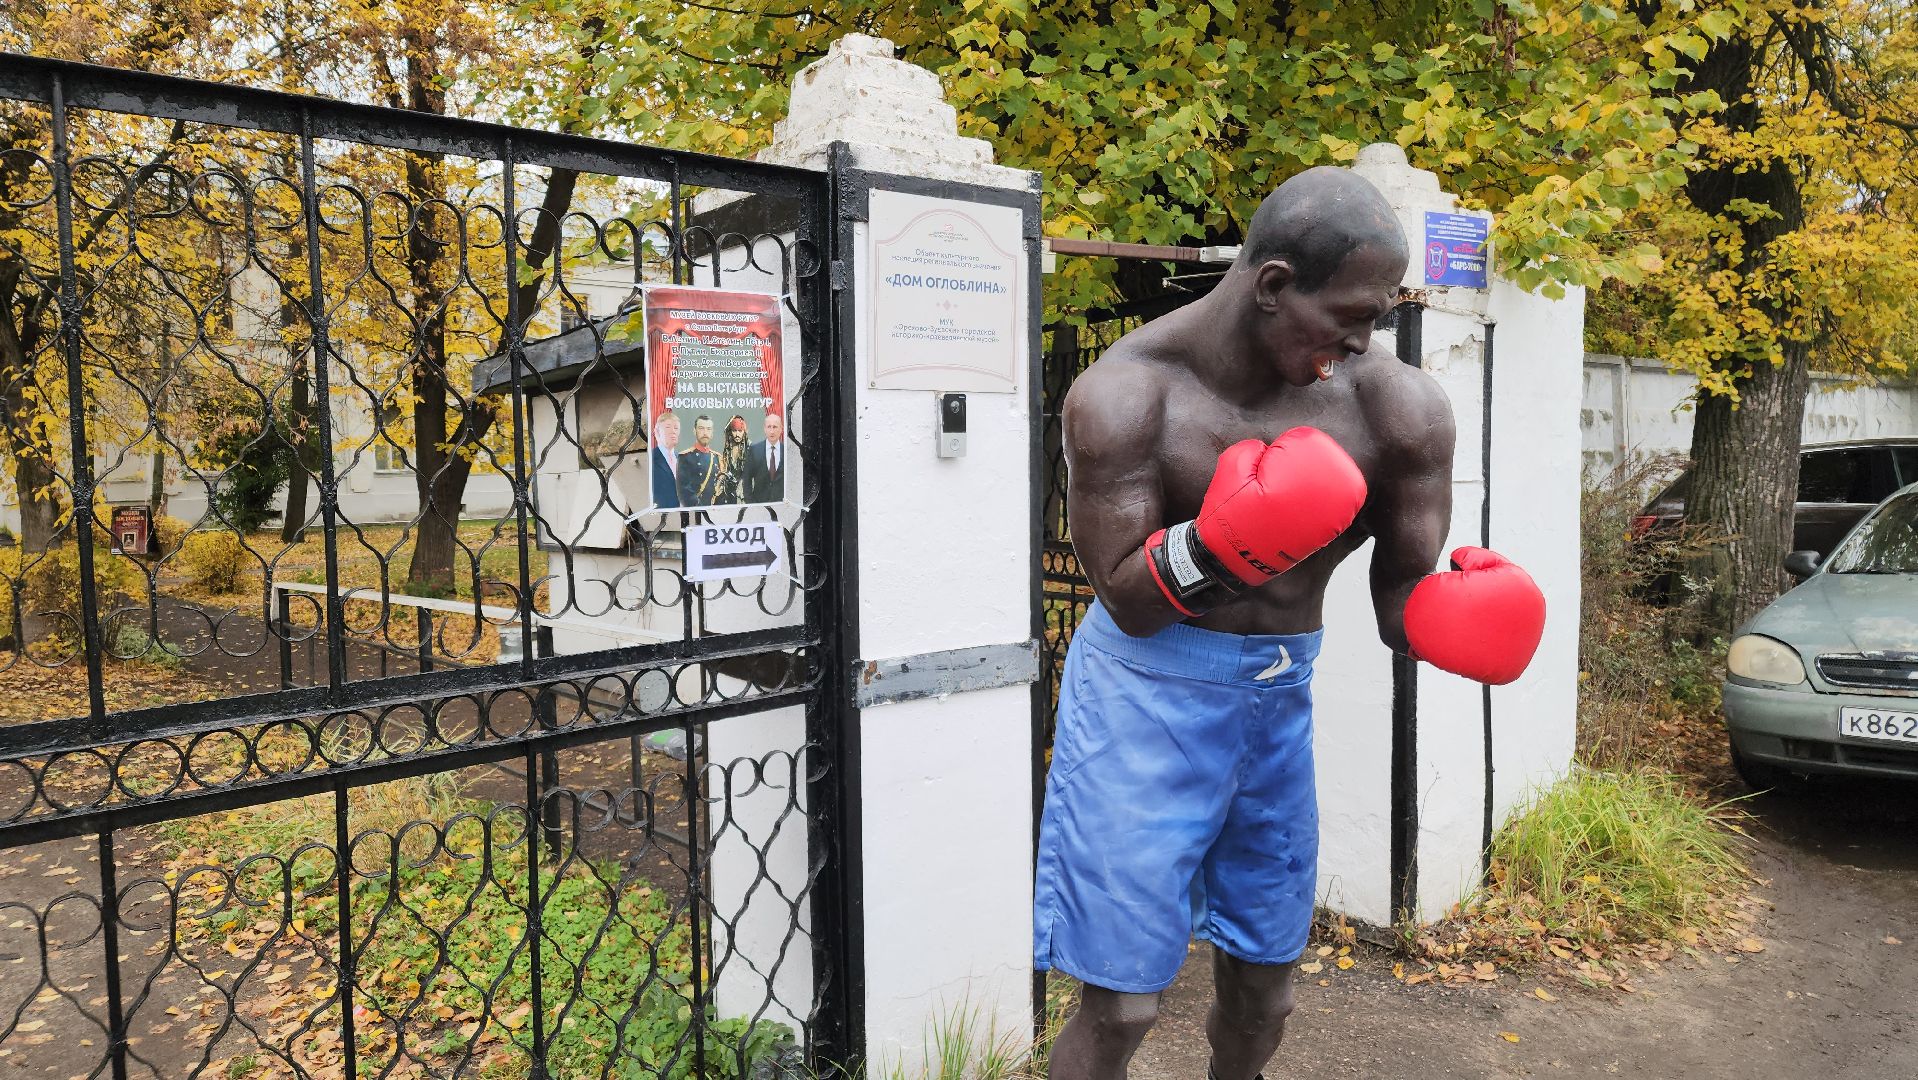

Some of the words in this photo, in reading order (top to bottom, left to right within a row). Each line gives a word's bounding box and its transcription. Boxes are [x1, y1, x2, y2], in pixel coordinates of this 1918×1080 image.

[885, 273, 922, 288] «ДОМ
[925, 276, 1007, 294] ОГЛОБЛИНА»
[677, 382, 695, 394] НА
[697, 382, 761, 394] ВЫСТАВКЕ
[665, 397, 734, 409] ВОСКОВЫХ
[735, 397, 773, 409] ФИГУР
[704, 526, 766, 546] ВХОД
